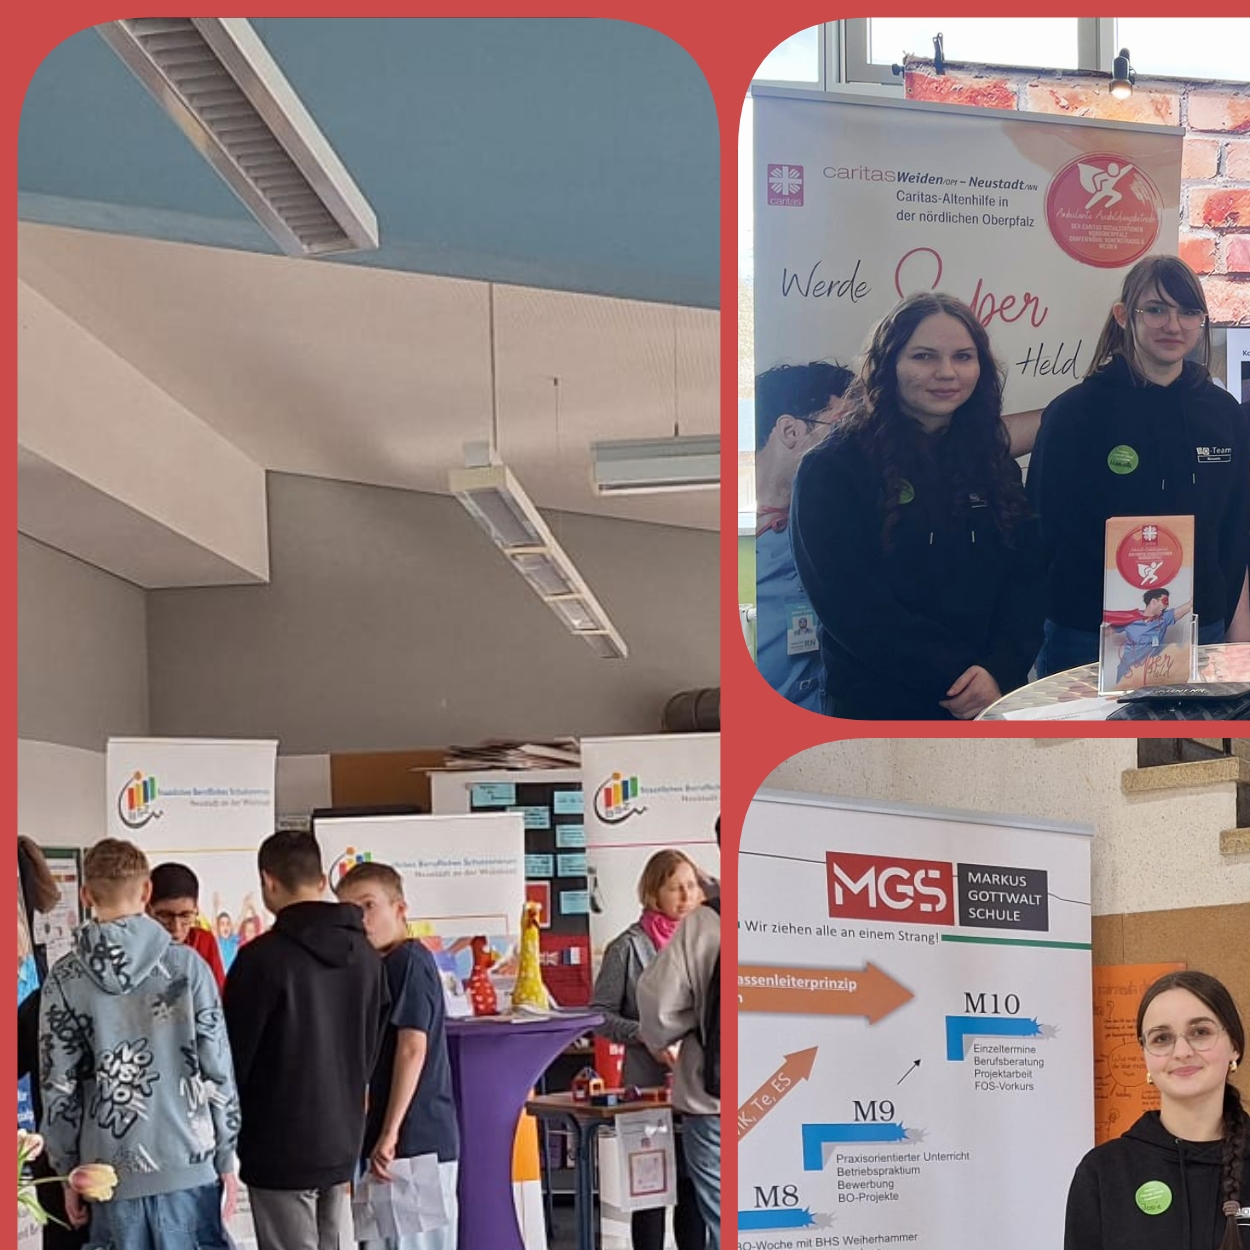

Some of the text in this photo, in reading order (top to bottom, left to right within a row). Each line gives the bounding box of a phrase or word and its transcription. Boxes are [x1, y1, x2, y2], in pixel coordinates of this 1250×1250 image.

[823, 166, 896, 182] caritas
[896, 190, 1009, 207] Caritas-Altenhilfe in
[896, 210, 1035, 228] der nördlichen Oberpfalz
[782, 259, 872, 303] Werde
[1016, 340, 1083, 380] Held
[833, 862, 947, 912] MGS
[968, 872, 1026, 887] MARKUS
[968, 890, 1042, 906] GOTTWALT
[968, 908, 1020, 922] SCHULE
[745, 920, 940, 945] Wir ziehen alle an einem Strang!
[964, 992, 1020, 1014] M10
[973, 1044, 1036, 1054] Einzeltermine
[974, 1056, 1044, 1068] Berufsberatung
[974, 1068, 1032, 1080] Projektarbeit
[751, 1072, 792, 1112] Te, ES
[974, 1081, 1034, 1092] FOS-Vorkurs
[853, 1100, 894, 1122] M9
[836, 1150, 970, 1164] Praxisorientierter Unterricht
[837, 1165, 920, 1177] Betriebspraktium
[838, 1178, 894, 1191] Bewerbung
[754, 1184, 799, 1208] M8
[838, 1191, 899, 1202] BO-Projekte
[796, 1238, 812, 1248] mit
[815, 1236, 840, 1248] BHS
[842, 1232, 918, 1246] Weiherhammer
